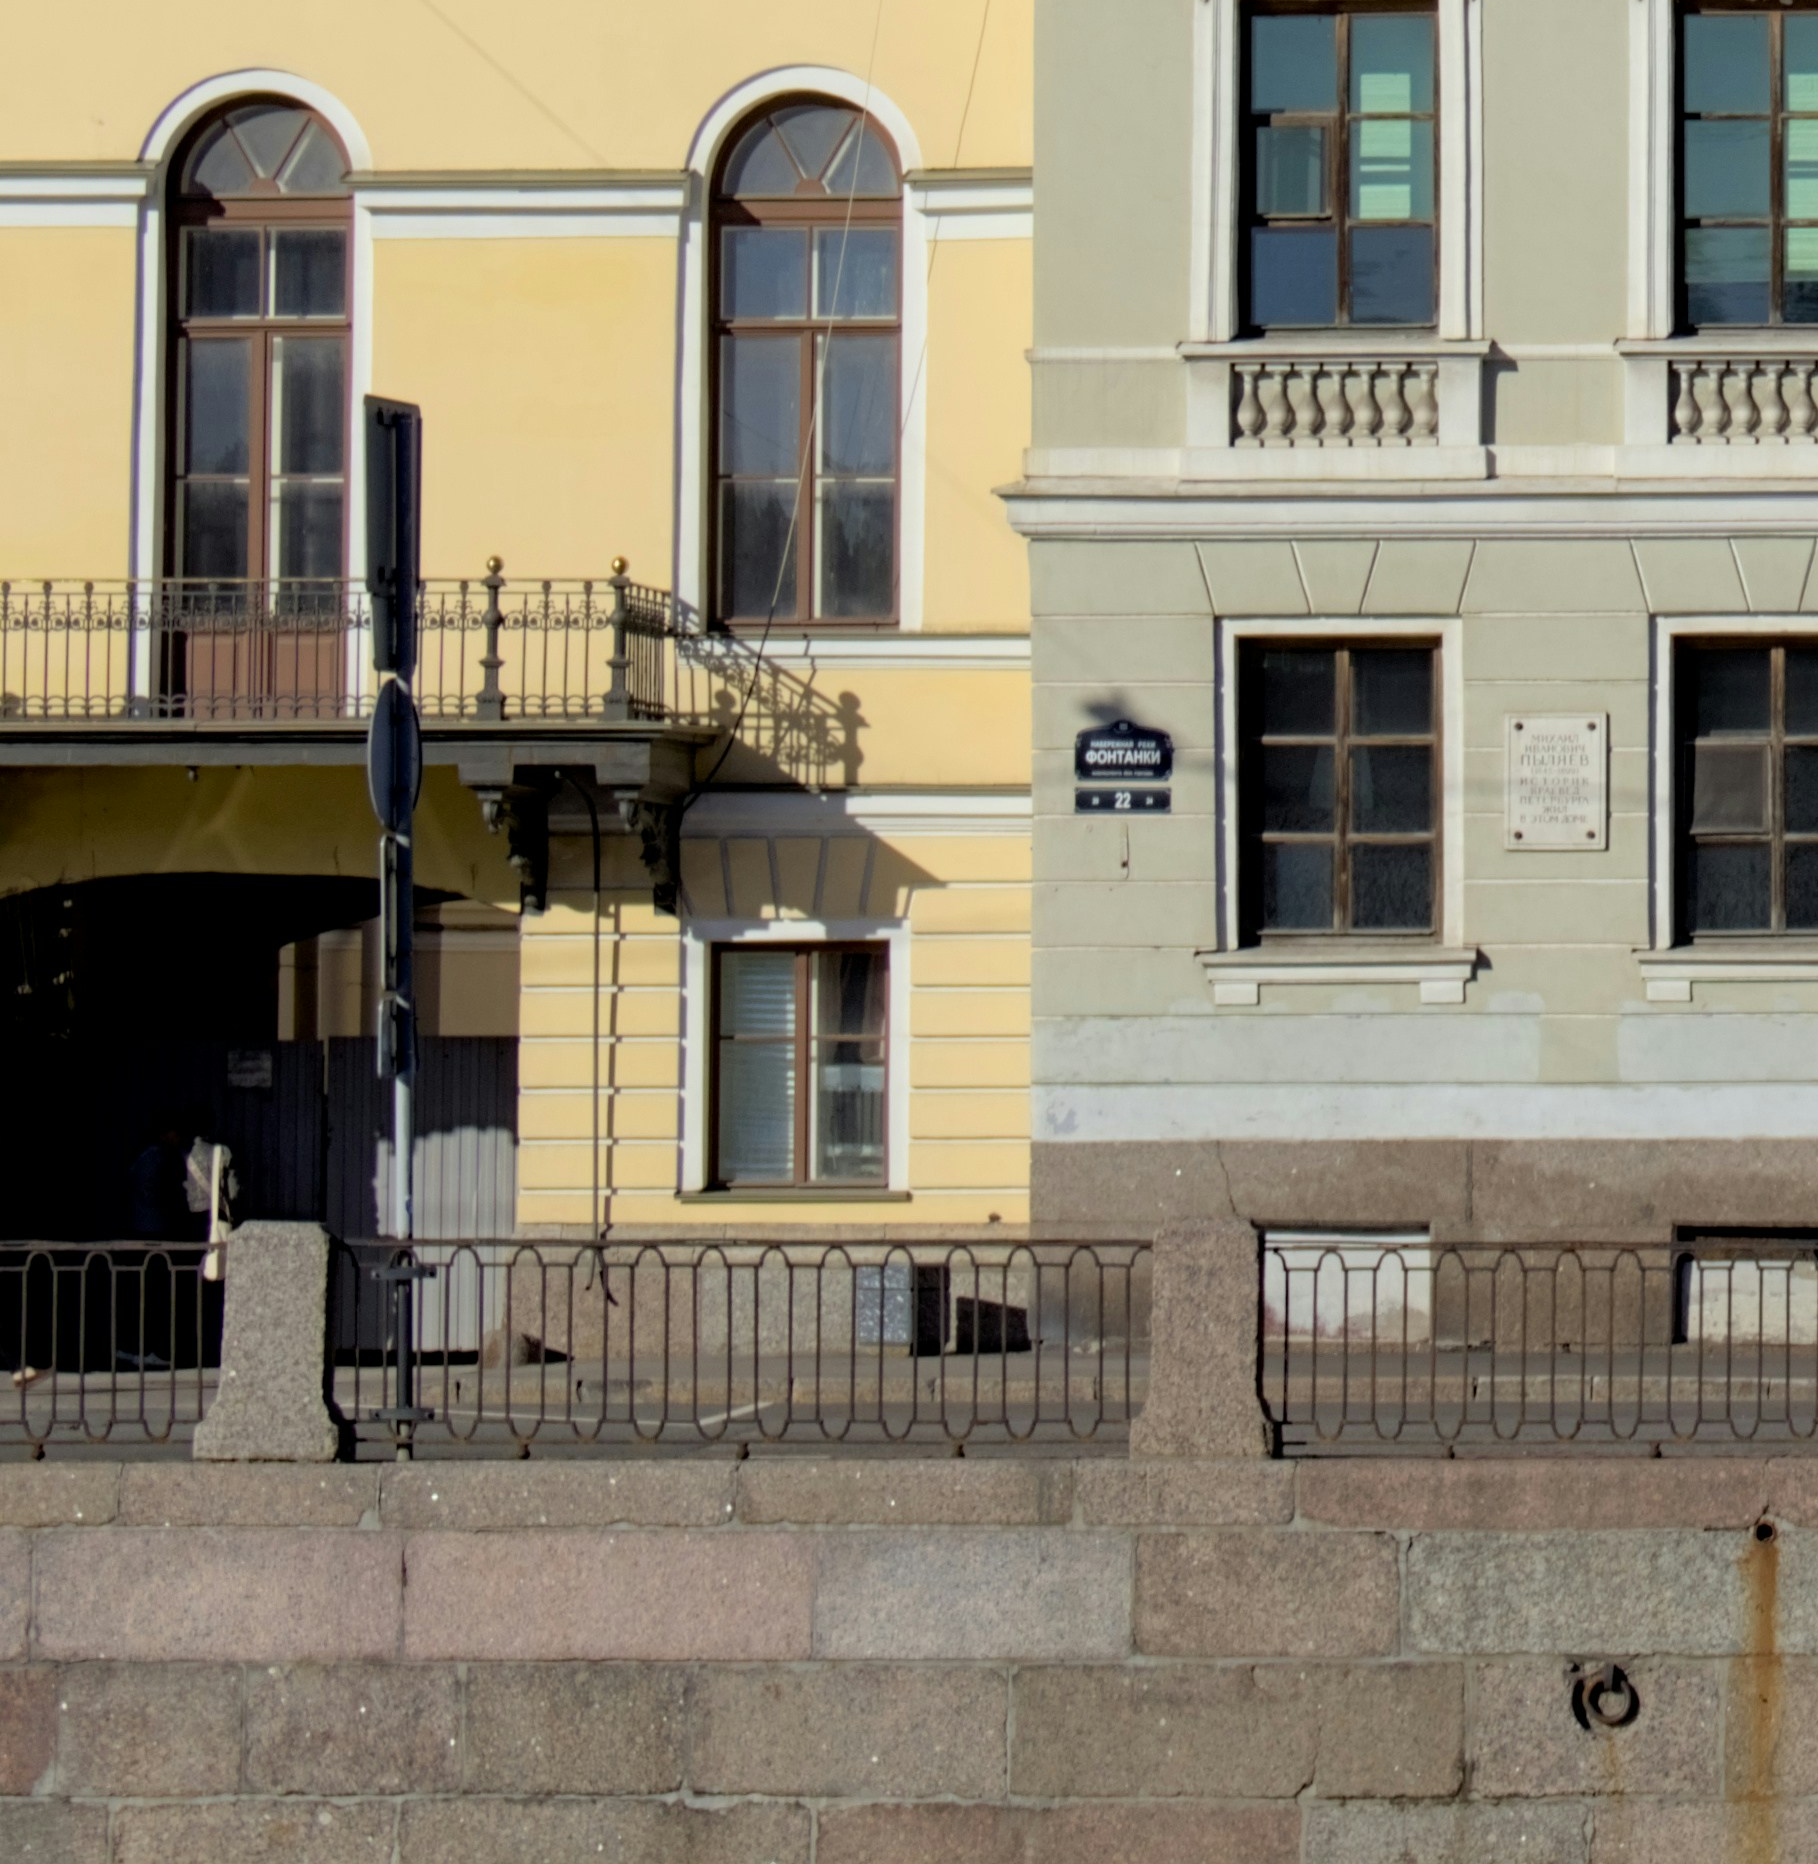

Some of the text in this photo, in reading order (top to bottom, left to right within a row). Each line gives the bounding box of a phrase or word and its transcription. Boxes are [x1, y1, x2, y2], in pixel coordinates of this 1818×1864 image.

[1090, 740, 1156, 749] НАБЕРЕЖНАЯ РЕКИ
[1525, 744, 1585, 753] ИВАНОВИЧ
[1085, 749, 1161, 764] ФОНТАНКИ
[1520, 754, 1589, 766] ПЫЛЯЕВ
[1520, 777, 1589, 786] ИСТОРИК
[1114, 792, 1131, 809] 22
[1520, 796, 1589, 805] ПЕТЕРБУРГА
